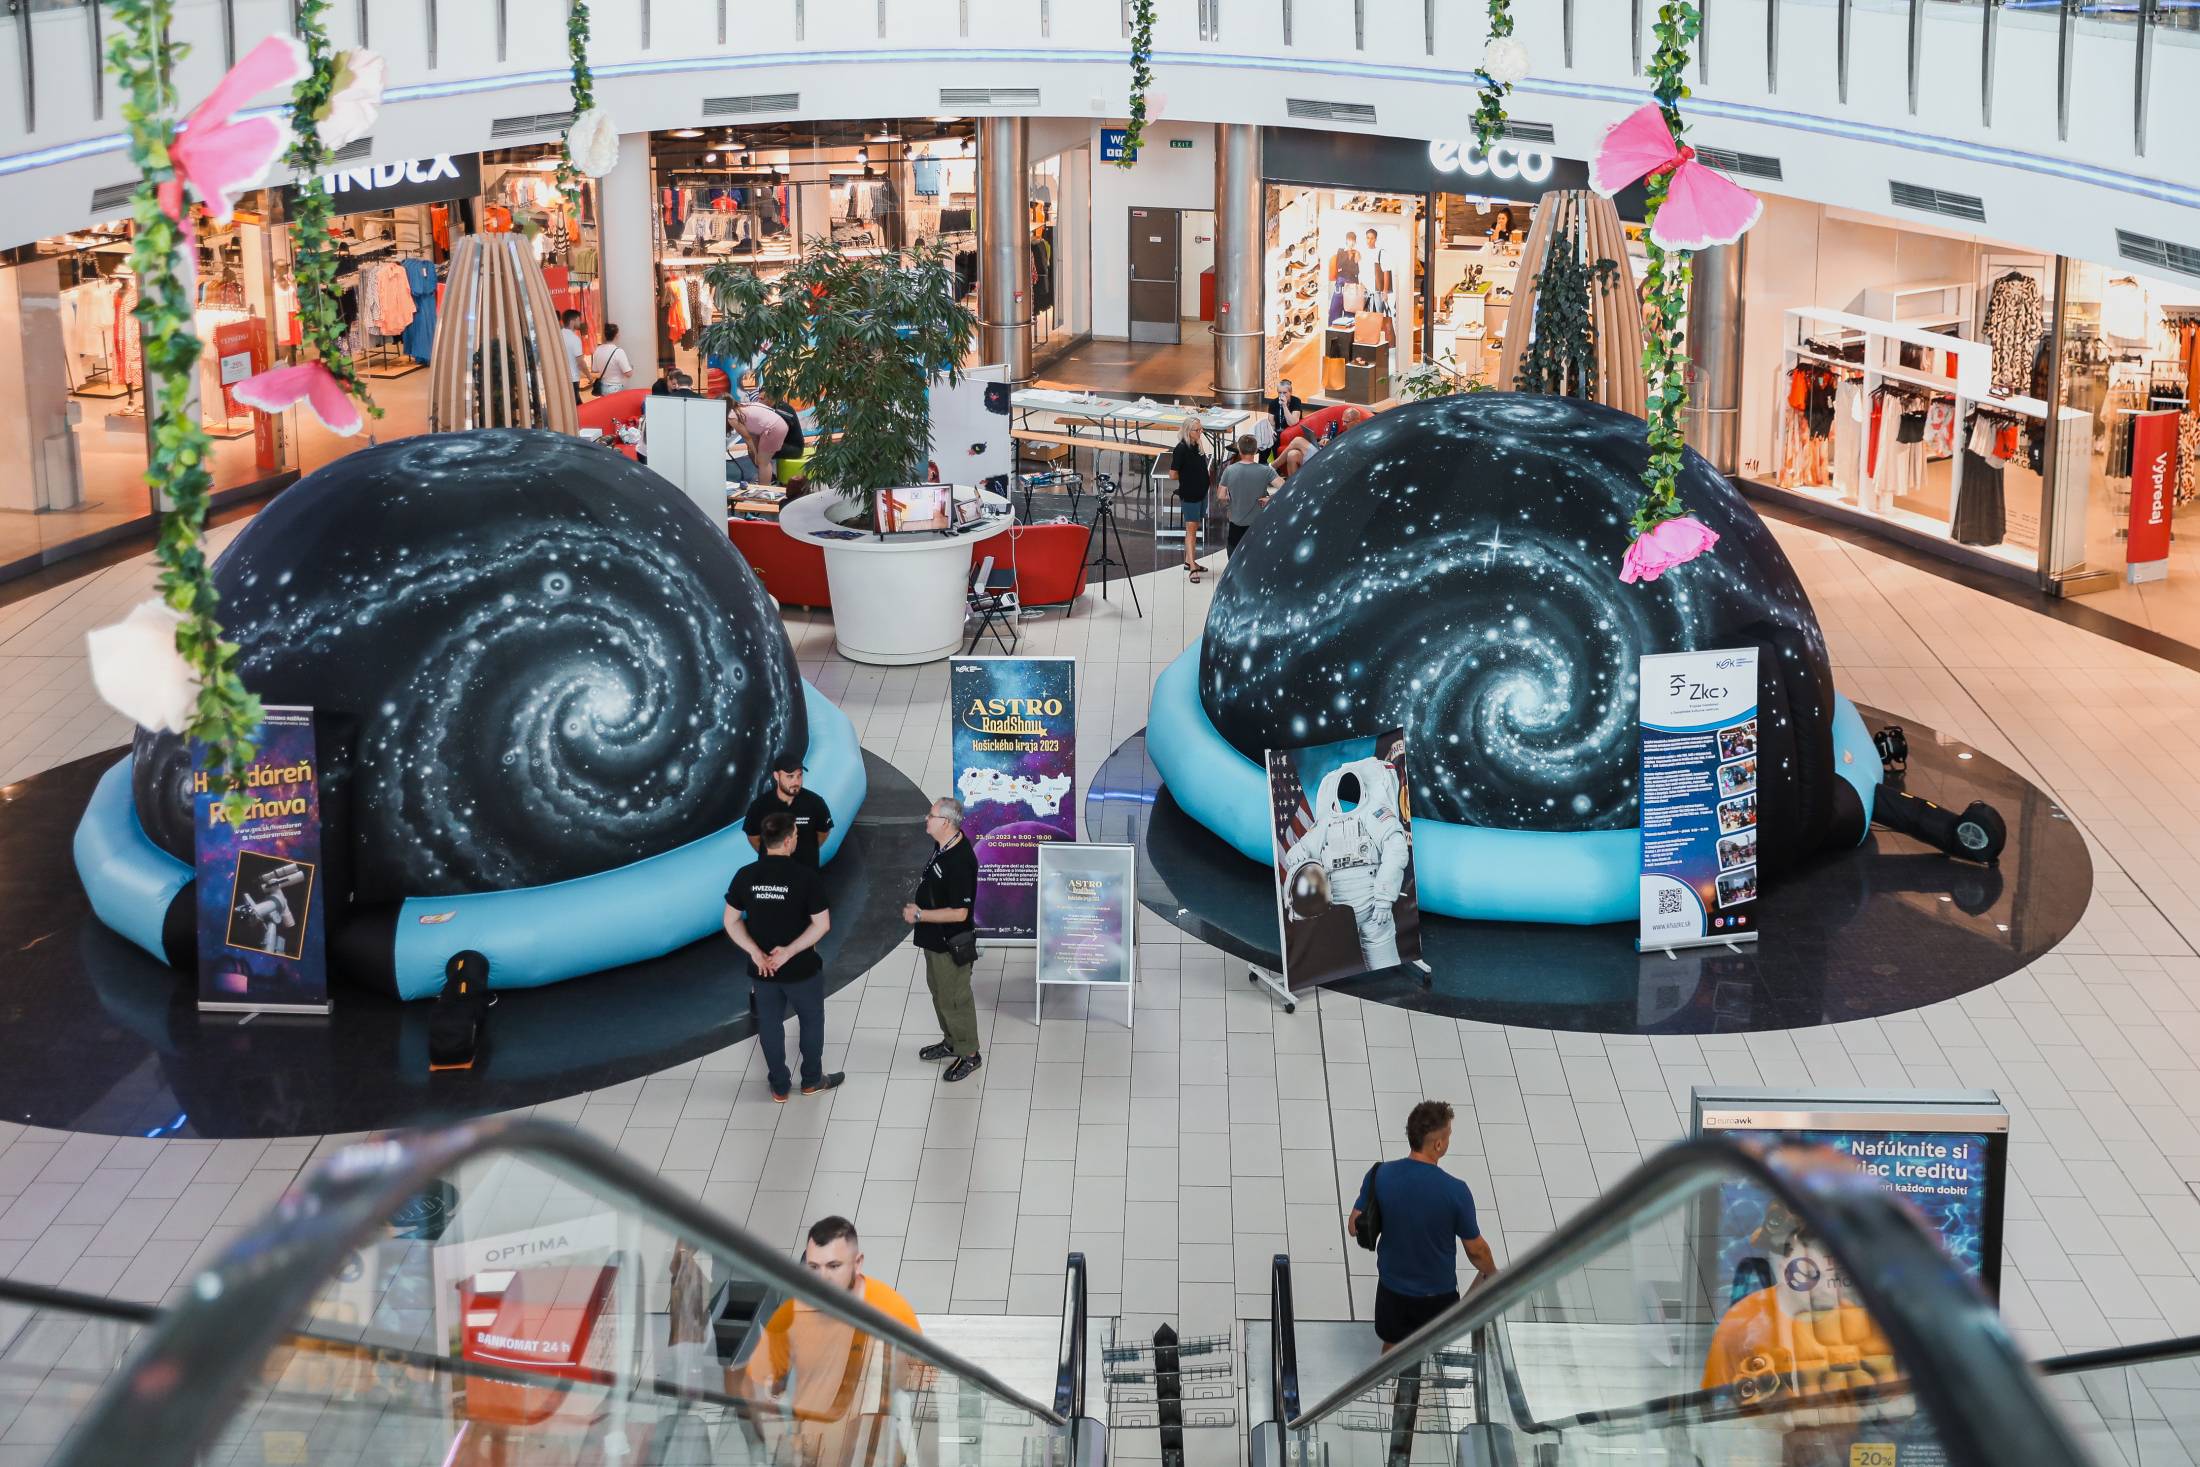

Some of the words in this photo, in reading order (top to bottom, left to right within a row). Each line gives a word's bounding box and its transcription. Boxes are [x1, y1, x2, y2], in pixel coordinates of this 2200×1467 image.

[1172, 141, 1190, 149] EXIT
[1429, 139, 1553, 182] ecco
[256, 330, 268, 453] VÝPDAJ
[2149, 452, 2168, 525] Výpredaj
[968, 698, 1063, 716] ASTRO
[982, 716, 1042, 732] RoadShow
[972, 738, 1014, 752] Košického
[1015, 739, 1039, 753] kraja
[1040, 739, 1059, 752] 2023
[194, 760, 312, 793] Hdáreň
[1068, 879, 1103, 889] ASTRO
[1851, 1140, 1948, 1159] Nafúknite
[1952, 1143, 1969, 1160] si
[1895, 1161, 1968, 1181] kreditu
[1895, 1183, 1935, 1194] každom
[485, 1236, 569, 1263] OPTIMA
[477, 1332, 539, 1352] BANKOMAT
[543, 1341, 558, 1353] 24
